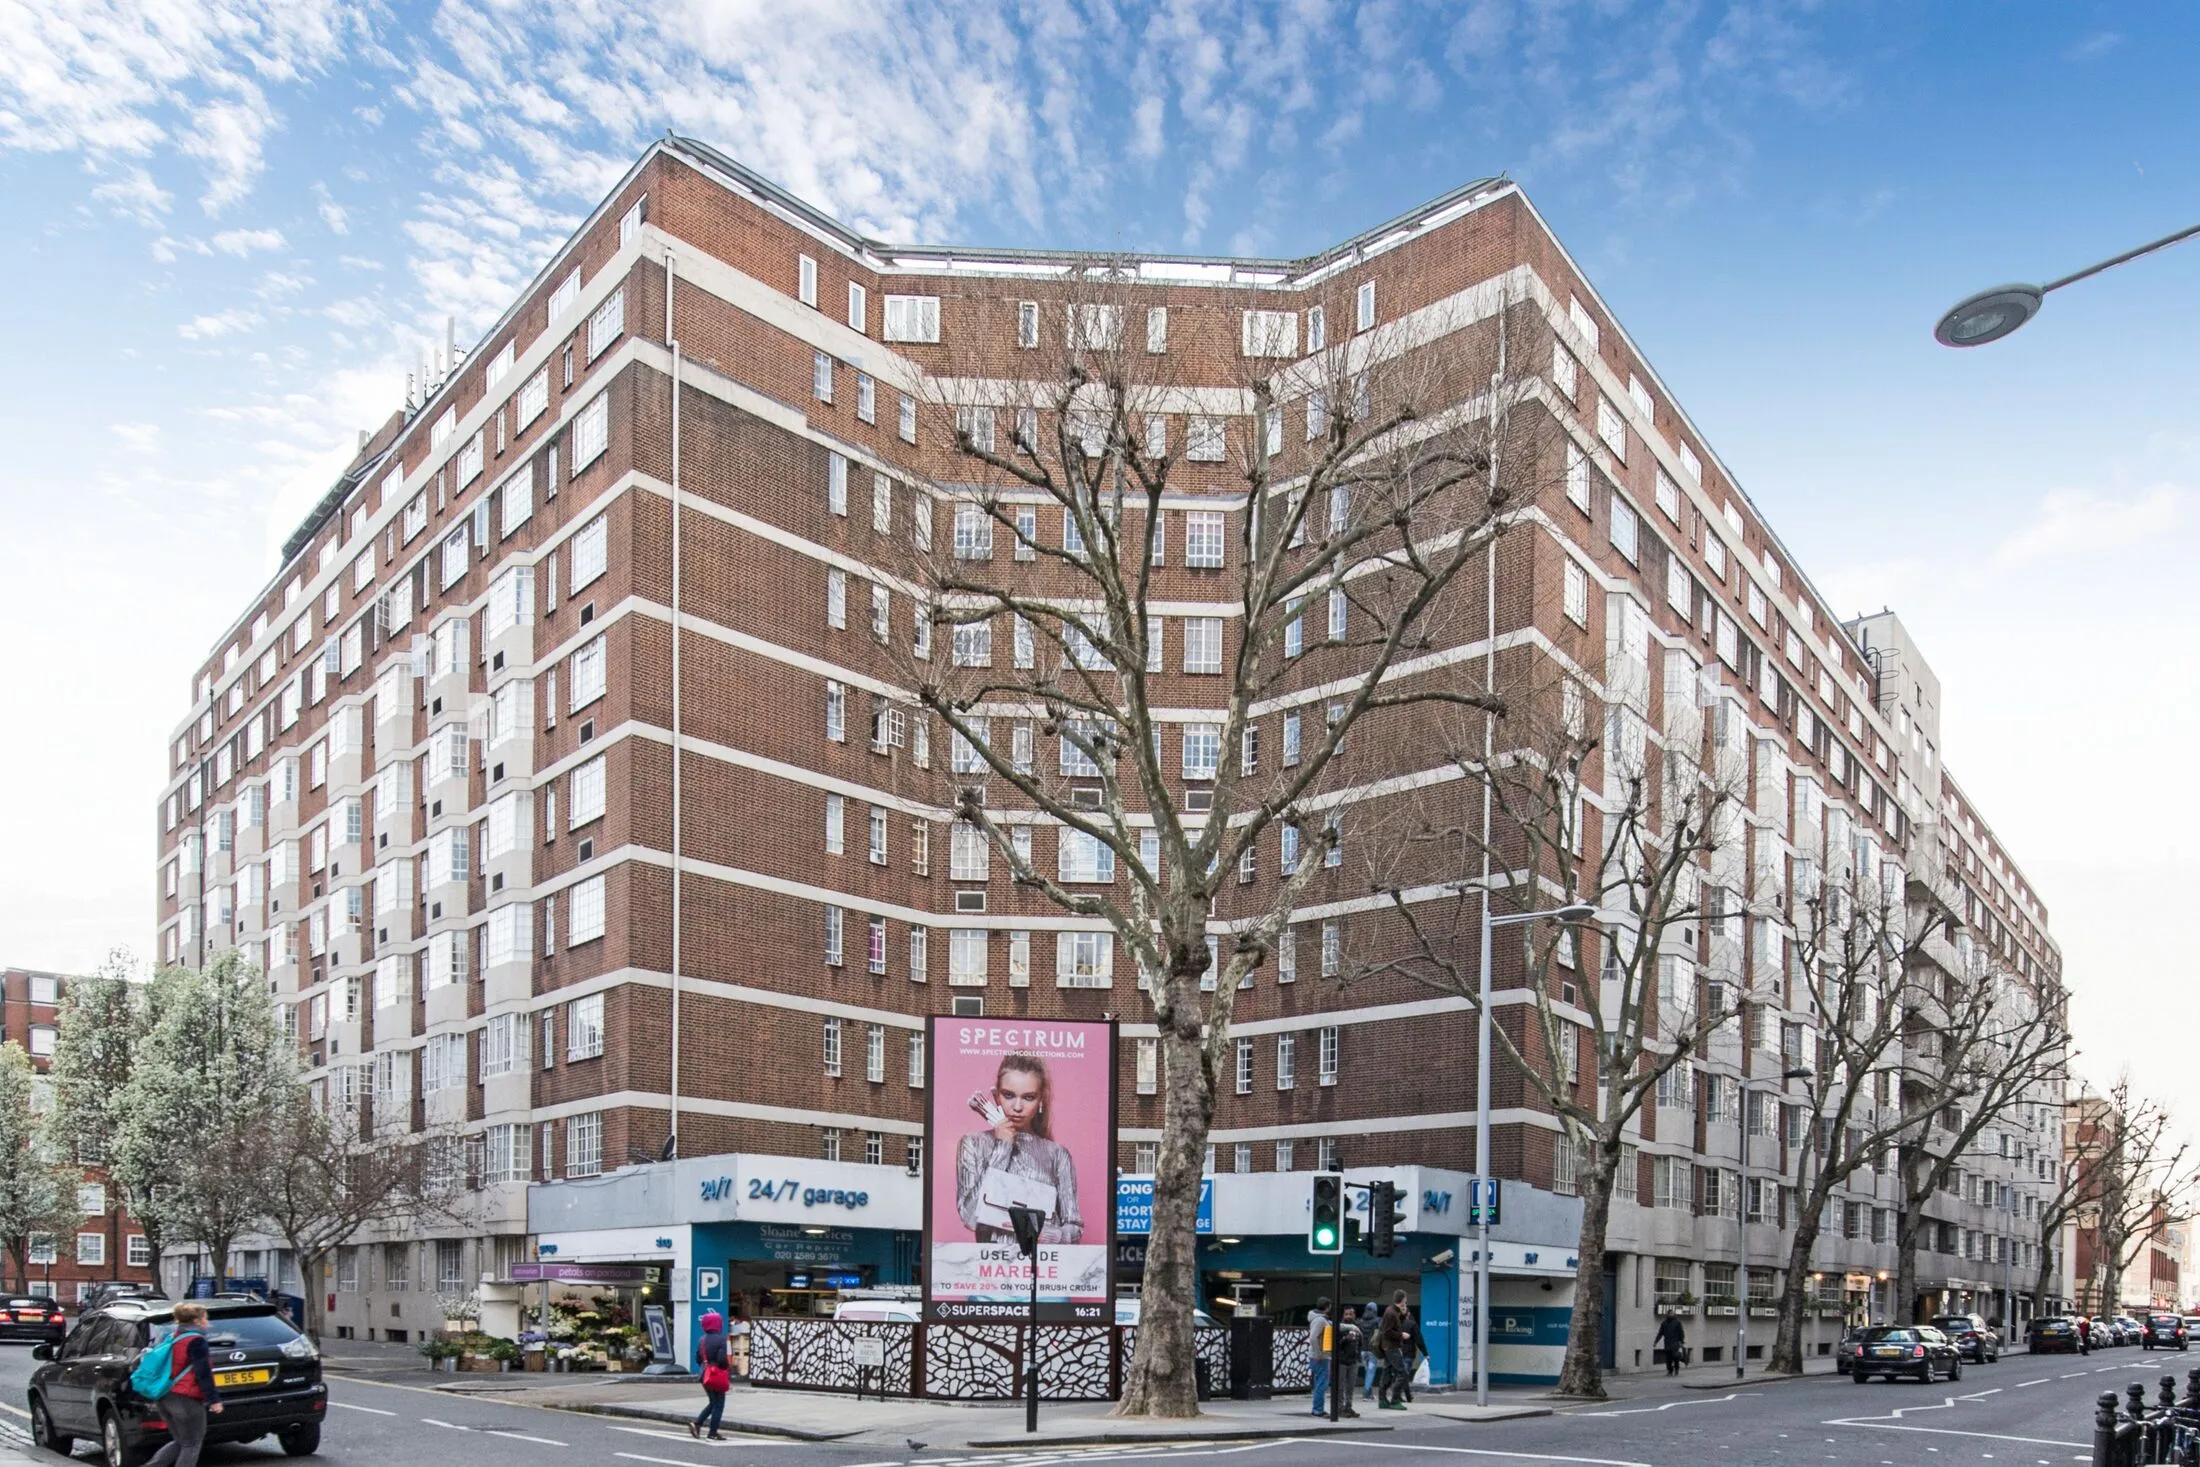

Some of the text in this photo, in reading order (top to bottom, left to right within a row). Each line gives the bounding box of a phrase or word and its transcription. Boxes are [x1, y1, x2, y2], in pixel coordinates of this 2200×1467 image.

[959, 1027, 1085, 1048] SPECTRUM
[701, 1176, 732, 1201] 24/7
[748, 1178, 869, 1210] 24/7 garage
[1117, 1183, 1153, 1195] ONG
[1126, 1196, 1140, 1204] OR
[1117, 1205, 1153, 1216] HORT
[1117, 1218, 1149, 1230] STAY
[774, 1251, 792, 1260] 020
[980, 1250, 1059, 1262] USE CDE
[558, 1268, 584, 1278] petals
[979, 1264, 1058, 1279] MARBLE
[701, 1271, 720, 1297] P
[941, 1282, 952, 1290] TO
[953, 1282, 977, 1290] SAVE
[979, 1282, 998, 1290] 20%
[1000, 1283, 1012, 1291] ON
[951, 1304, 1031, 1317] SUPERSPACE
[1075, 1307, 1101, 1317] 16:21
[652, 1322, 664, 1347] P
